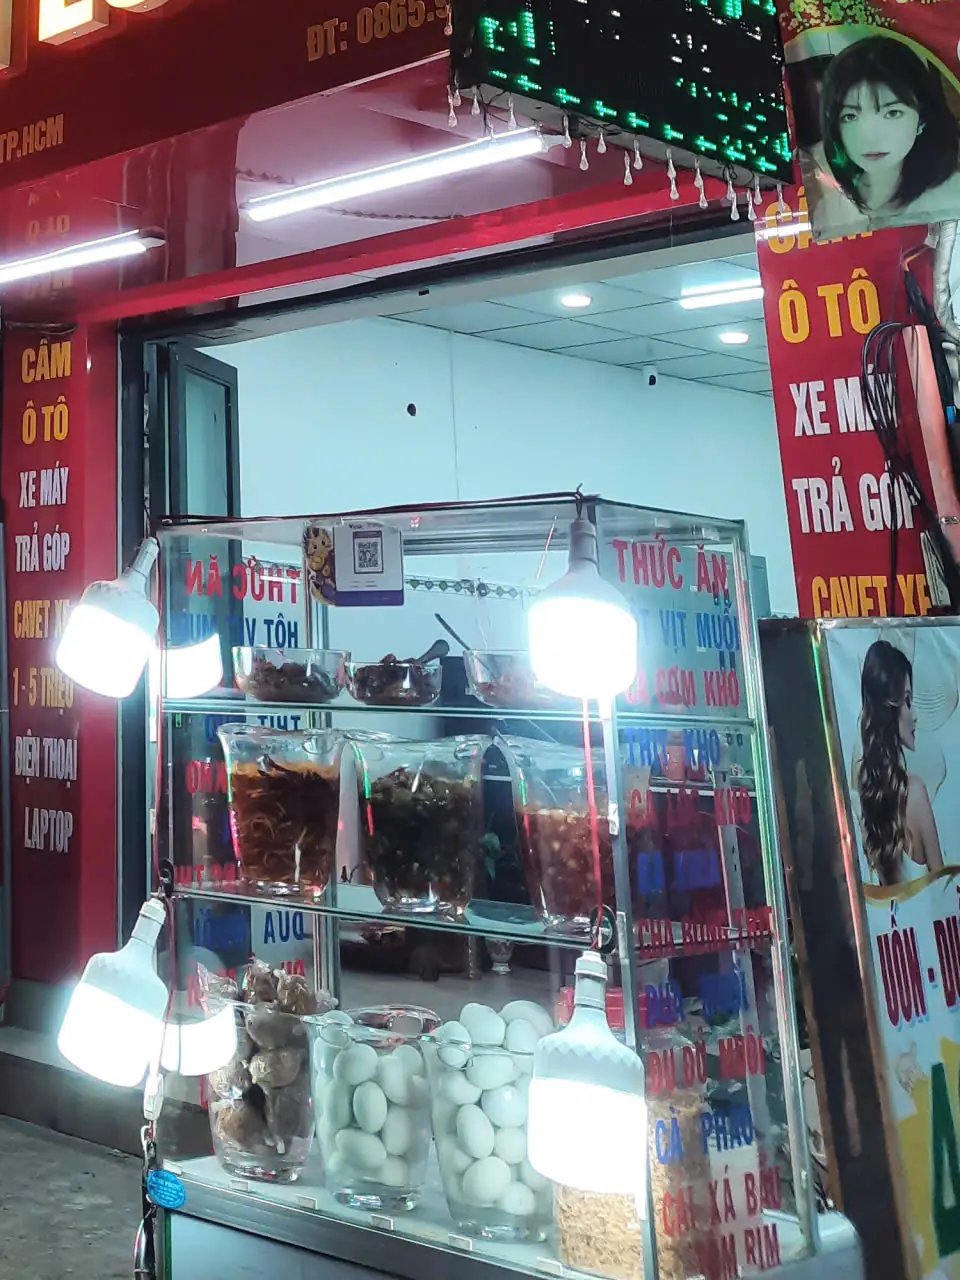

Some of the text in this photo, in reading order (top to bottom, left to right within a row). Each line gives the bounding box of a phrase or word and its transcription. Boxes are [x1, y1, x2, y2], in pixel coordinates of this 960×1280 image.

[307, 18, 347, 61] ĐT:
[778, 267, 881, 344] Ô TÔ
[22, 395, 69, 445] Ô TÔ
[789, 380, 831, 437] XE
[19, 461, 69, 508] XE MÁY
[792, 456, 855, 534] TRẢ
[15, 521, 71, 573] TRẢ GÓP
[613, 532, 730, 597] THỨC ĂN
[811, 575, 888, 618] CAVET
[12, 667, 19, 708] 1
[29, 668, 37, 708] 5
[43, 738, 78, 789] THOẠI
[24, 806, 74, 854] LAPTOP
